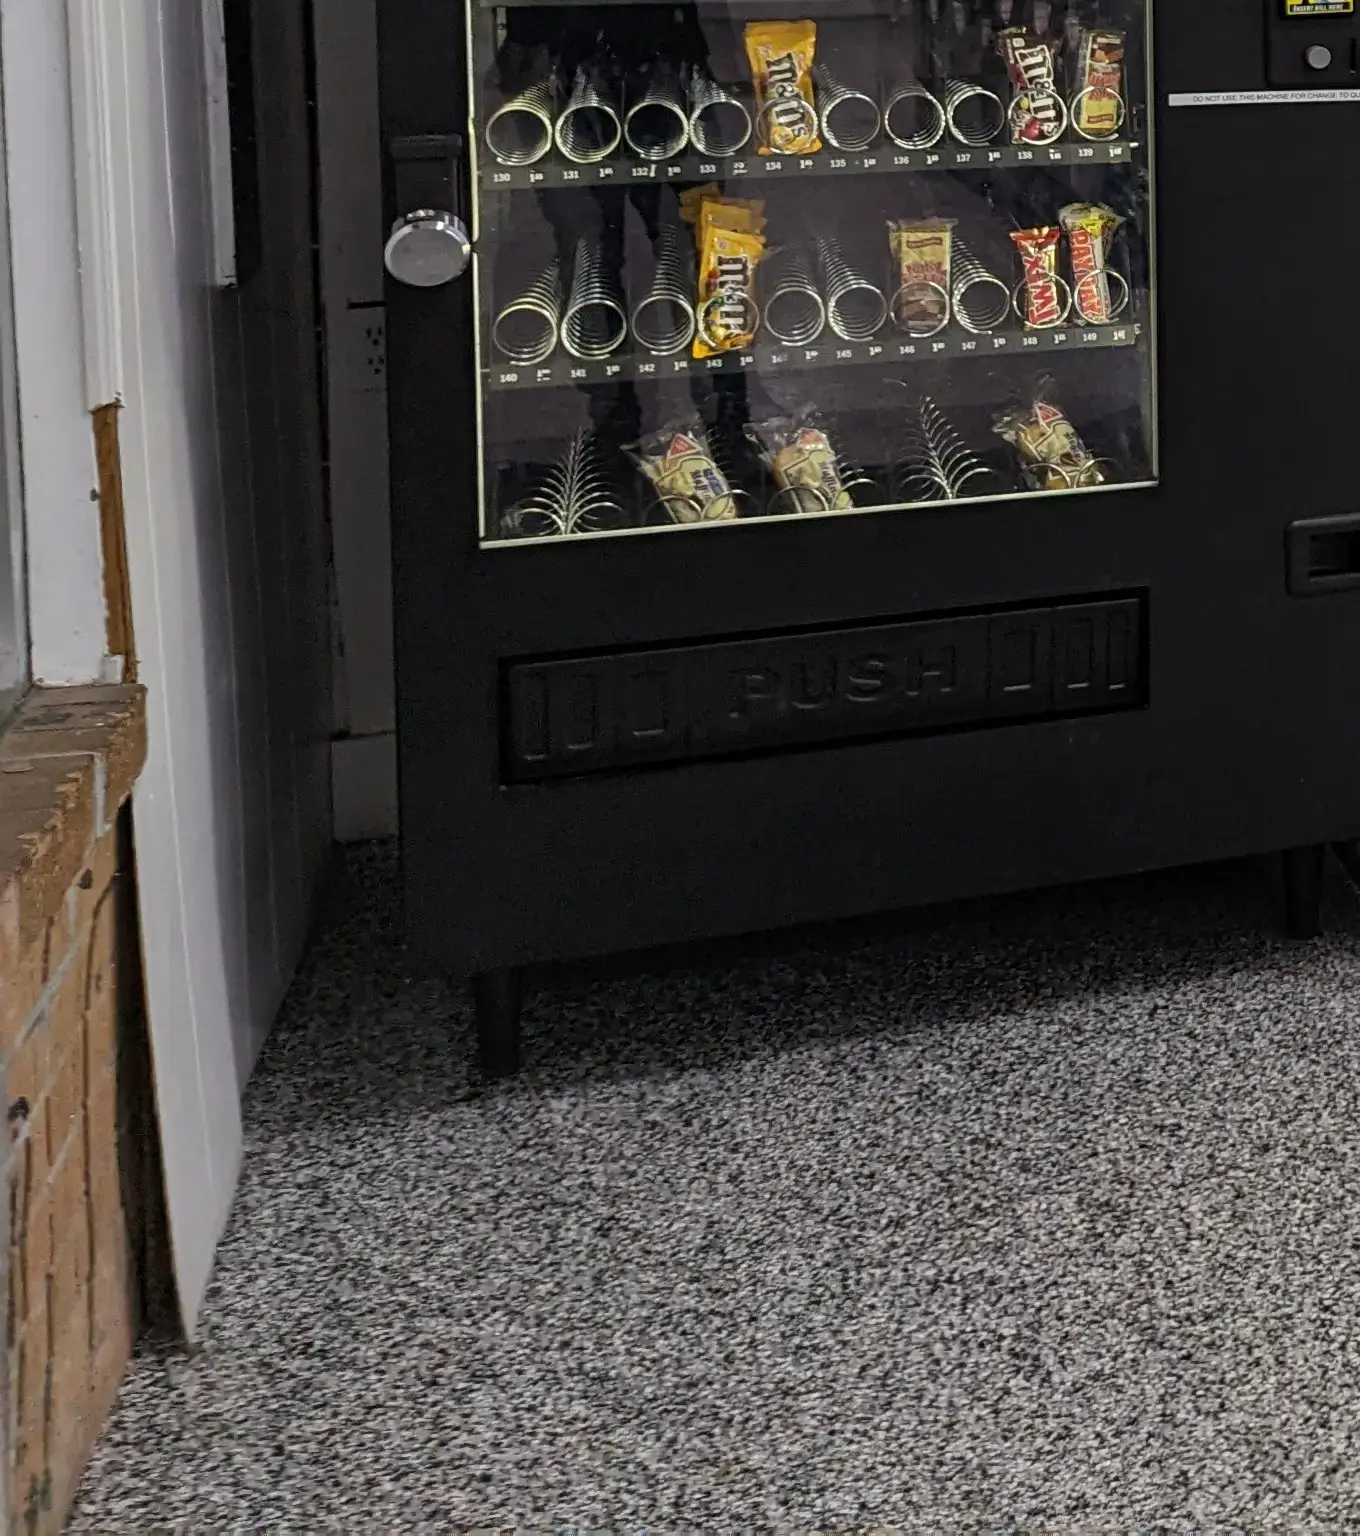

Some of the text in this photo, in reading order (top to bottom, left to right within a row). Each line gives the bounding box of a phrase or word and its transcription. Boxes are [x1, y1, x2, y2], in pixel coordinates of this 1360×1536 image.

[1205, 94, 1220, 102] NOT
[1239, 93, 1255, 101] THIS
[1256, 92, 1289, 100] MACHINE
[1291, 92, 1307, 100] FOR
[1078, 148, 1093, 157] 139
[830, 159, 846, 168] 135
[893, 156, 910, 165] 136
[956, 154, 971, 163] 137
[699, 164, 716, 174] 133
[765, 161, 782, 171] 134
[563, 170, 580, 180] 131
[632, 167, 649, 177] 132
[493, 173, 511, 183] 130
[1083, 332, 1097, 341] 149
[836, 349, 852, 359] 145
[706, 358, 723, 368] 143
[728, 644, 955, 720] PUSH
